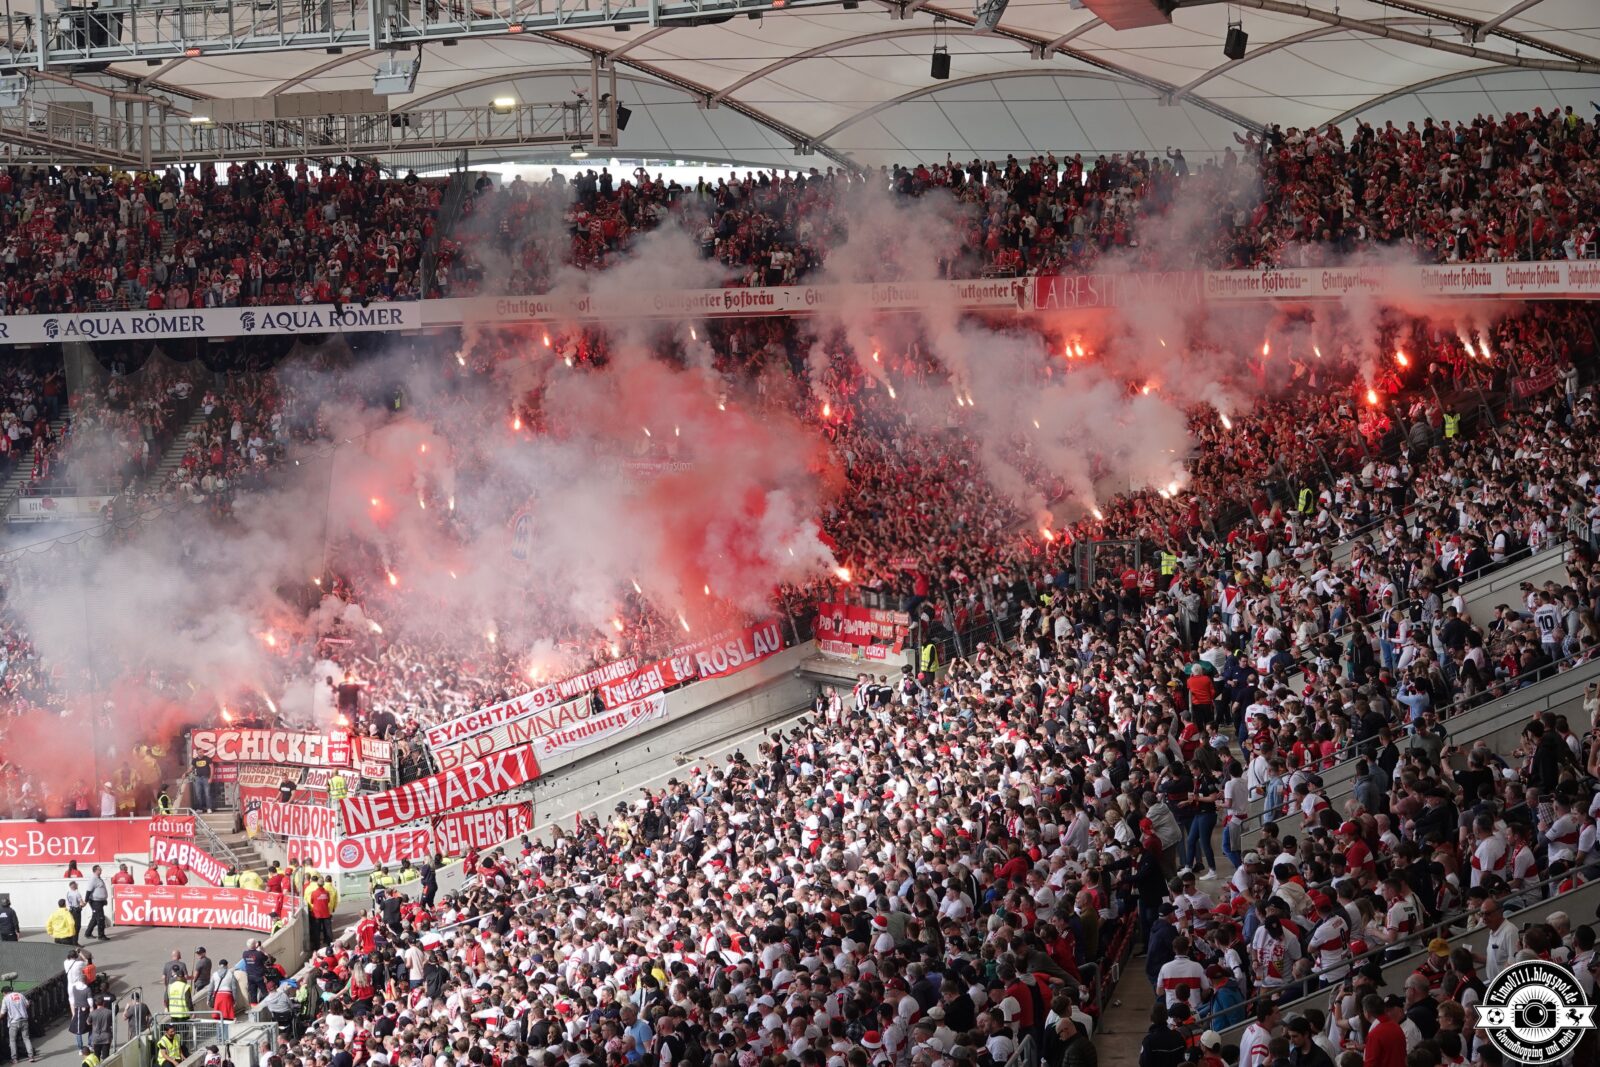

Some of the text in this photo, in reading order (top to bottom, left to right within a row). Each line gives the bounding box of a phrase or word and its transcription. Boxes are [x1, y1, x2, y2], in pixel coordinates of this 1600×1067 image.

[1034, 277, 1059, 310] LA
[1064, 273, 1132, 309] BESTIA
[1207, 271, 1302, 294] Stuttgarter Hofbräu
[1420, 266, 1493, 291] Stuttgarter Hofbräu
[1505, 265, 1560, 291] Stuttgarter Hofbräu
[724, 291, 775, 310] Hofbräu
[64, 313, 205, 338] AQUA RÖMER
[261, 306, 404, 332] AQUA RÖMER
[1538, 614, 1555, 632] 10
[695, 624, 781, 678] RÖSLAU
[557, 657, 638, 697] WINTERLINGEN
[601, 664, 665, 708] Zwiesel
[428, 688, 556, 746] EYACHTAL 93
[436, 734, 495, 770] BAD
[506, 697, 591, 745] IMNAU
[343, 746, 530, 834] NEUMARKT
[261, 801, 336, 840] ROHRDORF
[437, 812, 506, 854] SELTERS
[0, 830, 96, 857] s-Benz
[287, 838, 325, 869] RED
